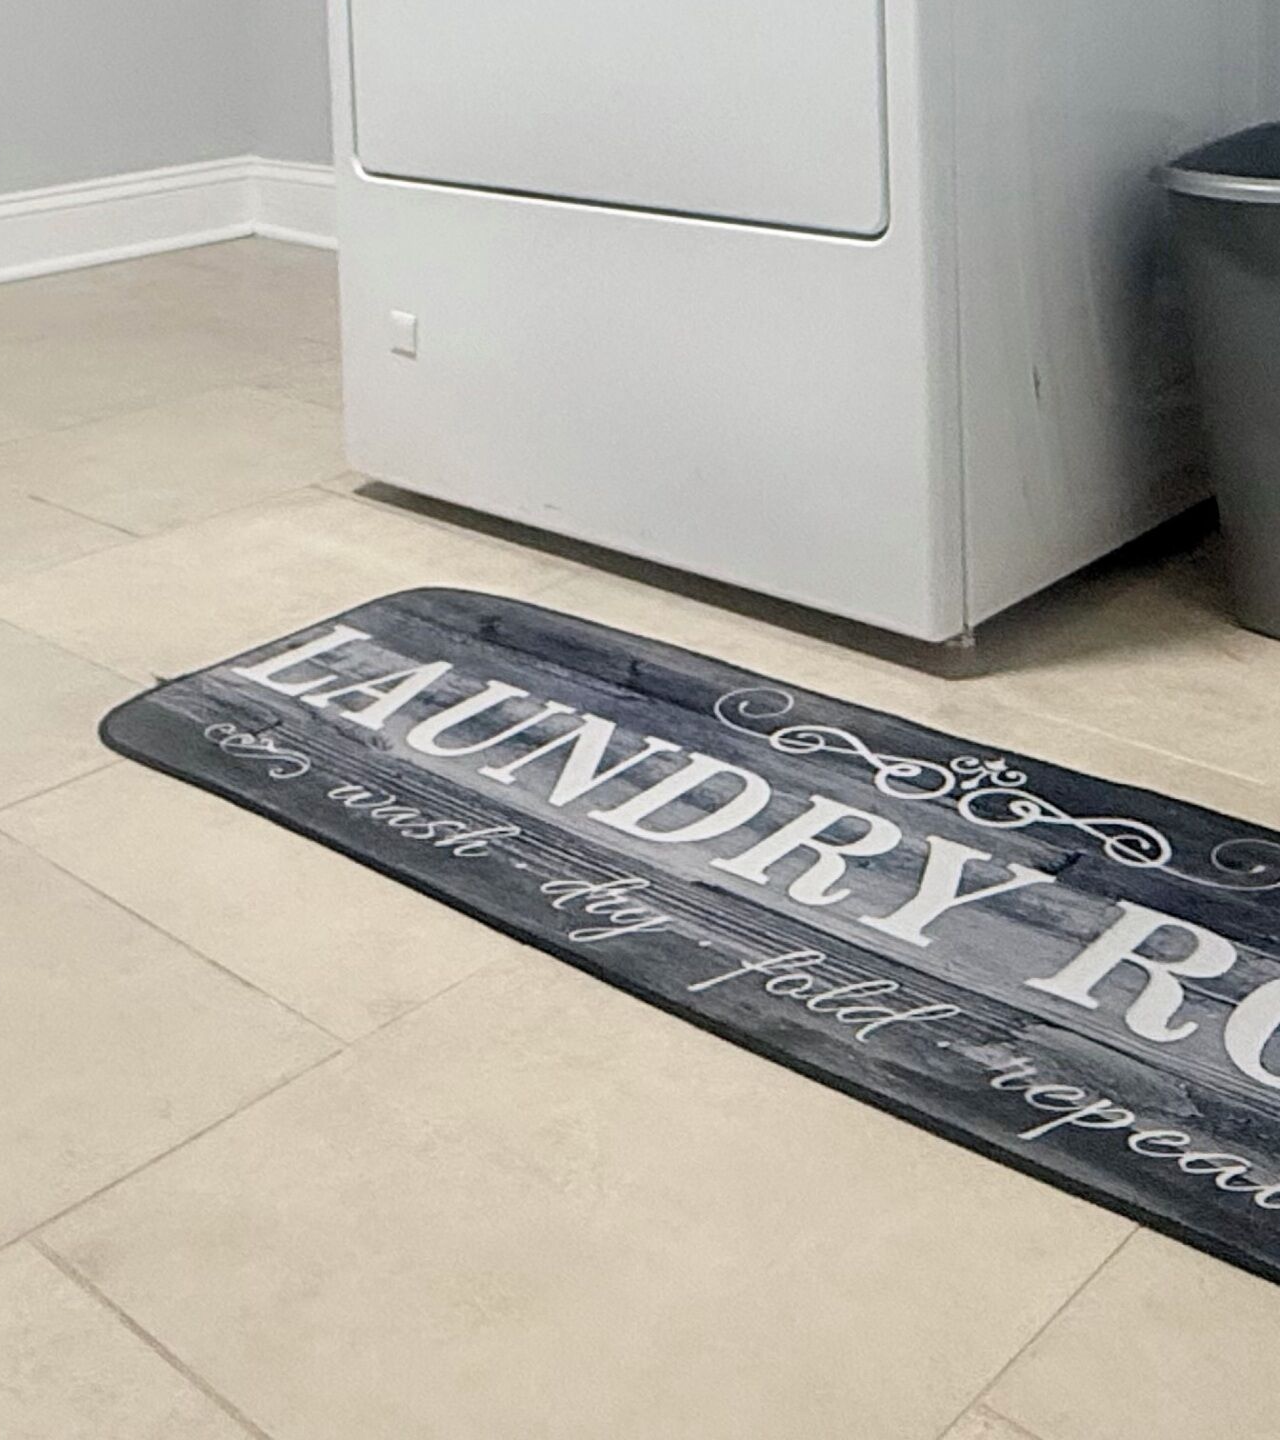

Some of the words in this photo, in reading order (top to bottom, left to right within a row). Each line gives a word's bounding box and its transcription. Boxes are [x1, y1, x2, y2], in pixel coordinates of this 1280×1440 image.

[232, 625, 1056, 947] LAUNDRY
[328, 780, 520, 860] wash
[541, 874, 668, 942] dry
[688, 948, 961, 1044] fold
